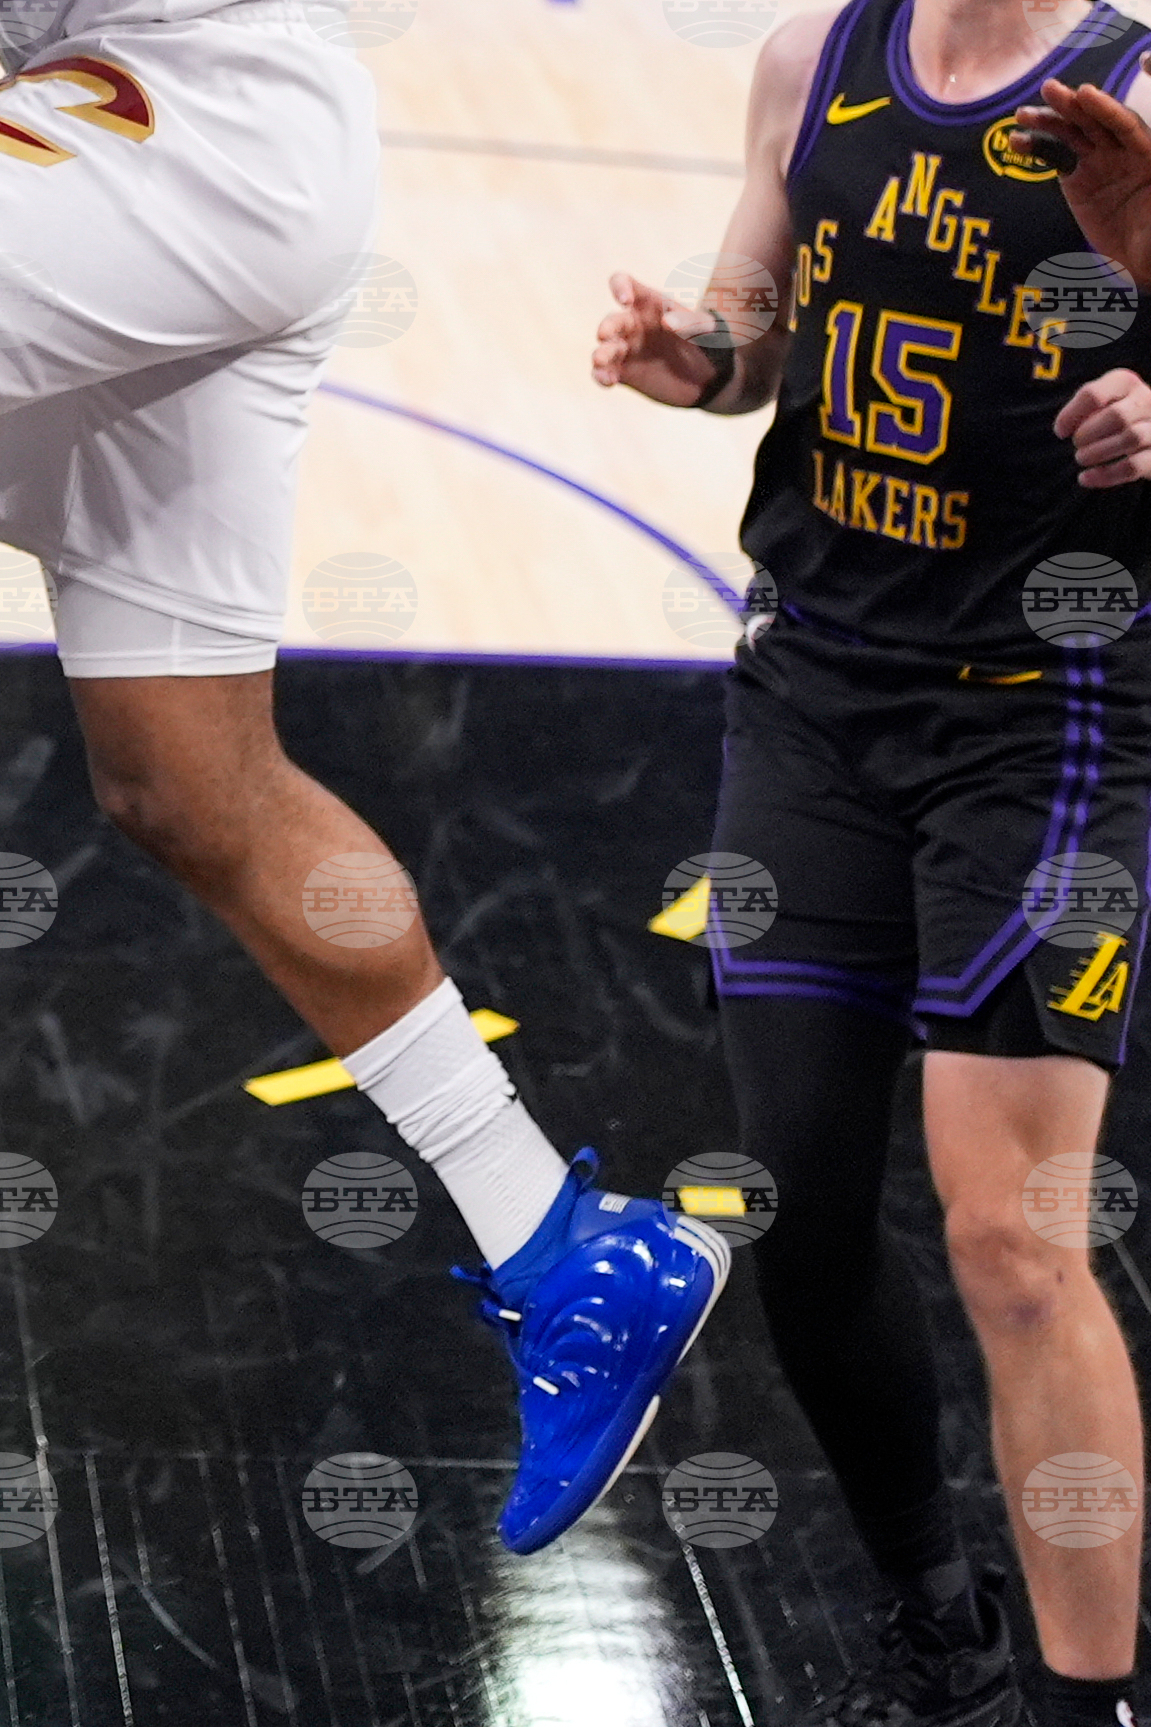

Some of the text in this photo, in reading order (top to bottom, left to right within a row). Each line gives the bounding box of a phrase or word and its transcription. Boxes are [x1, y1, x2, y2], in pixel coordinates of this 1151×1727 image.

[864, 151, 1067, 380] ANGELES
[819, 299, 963, 465] 15
[812, 450, 970, 550] LAKERS
